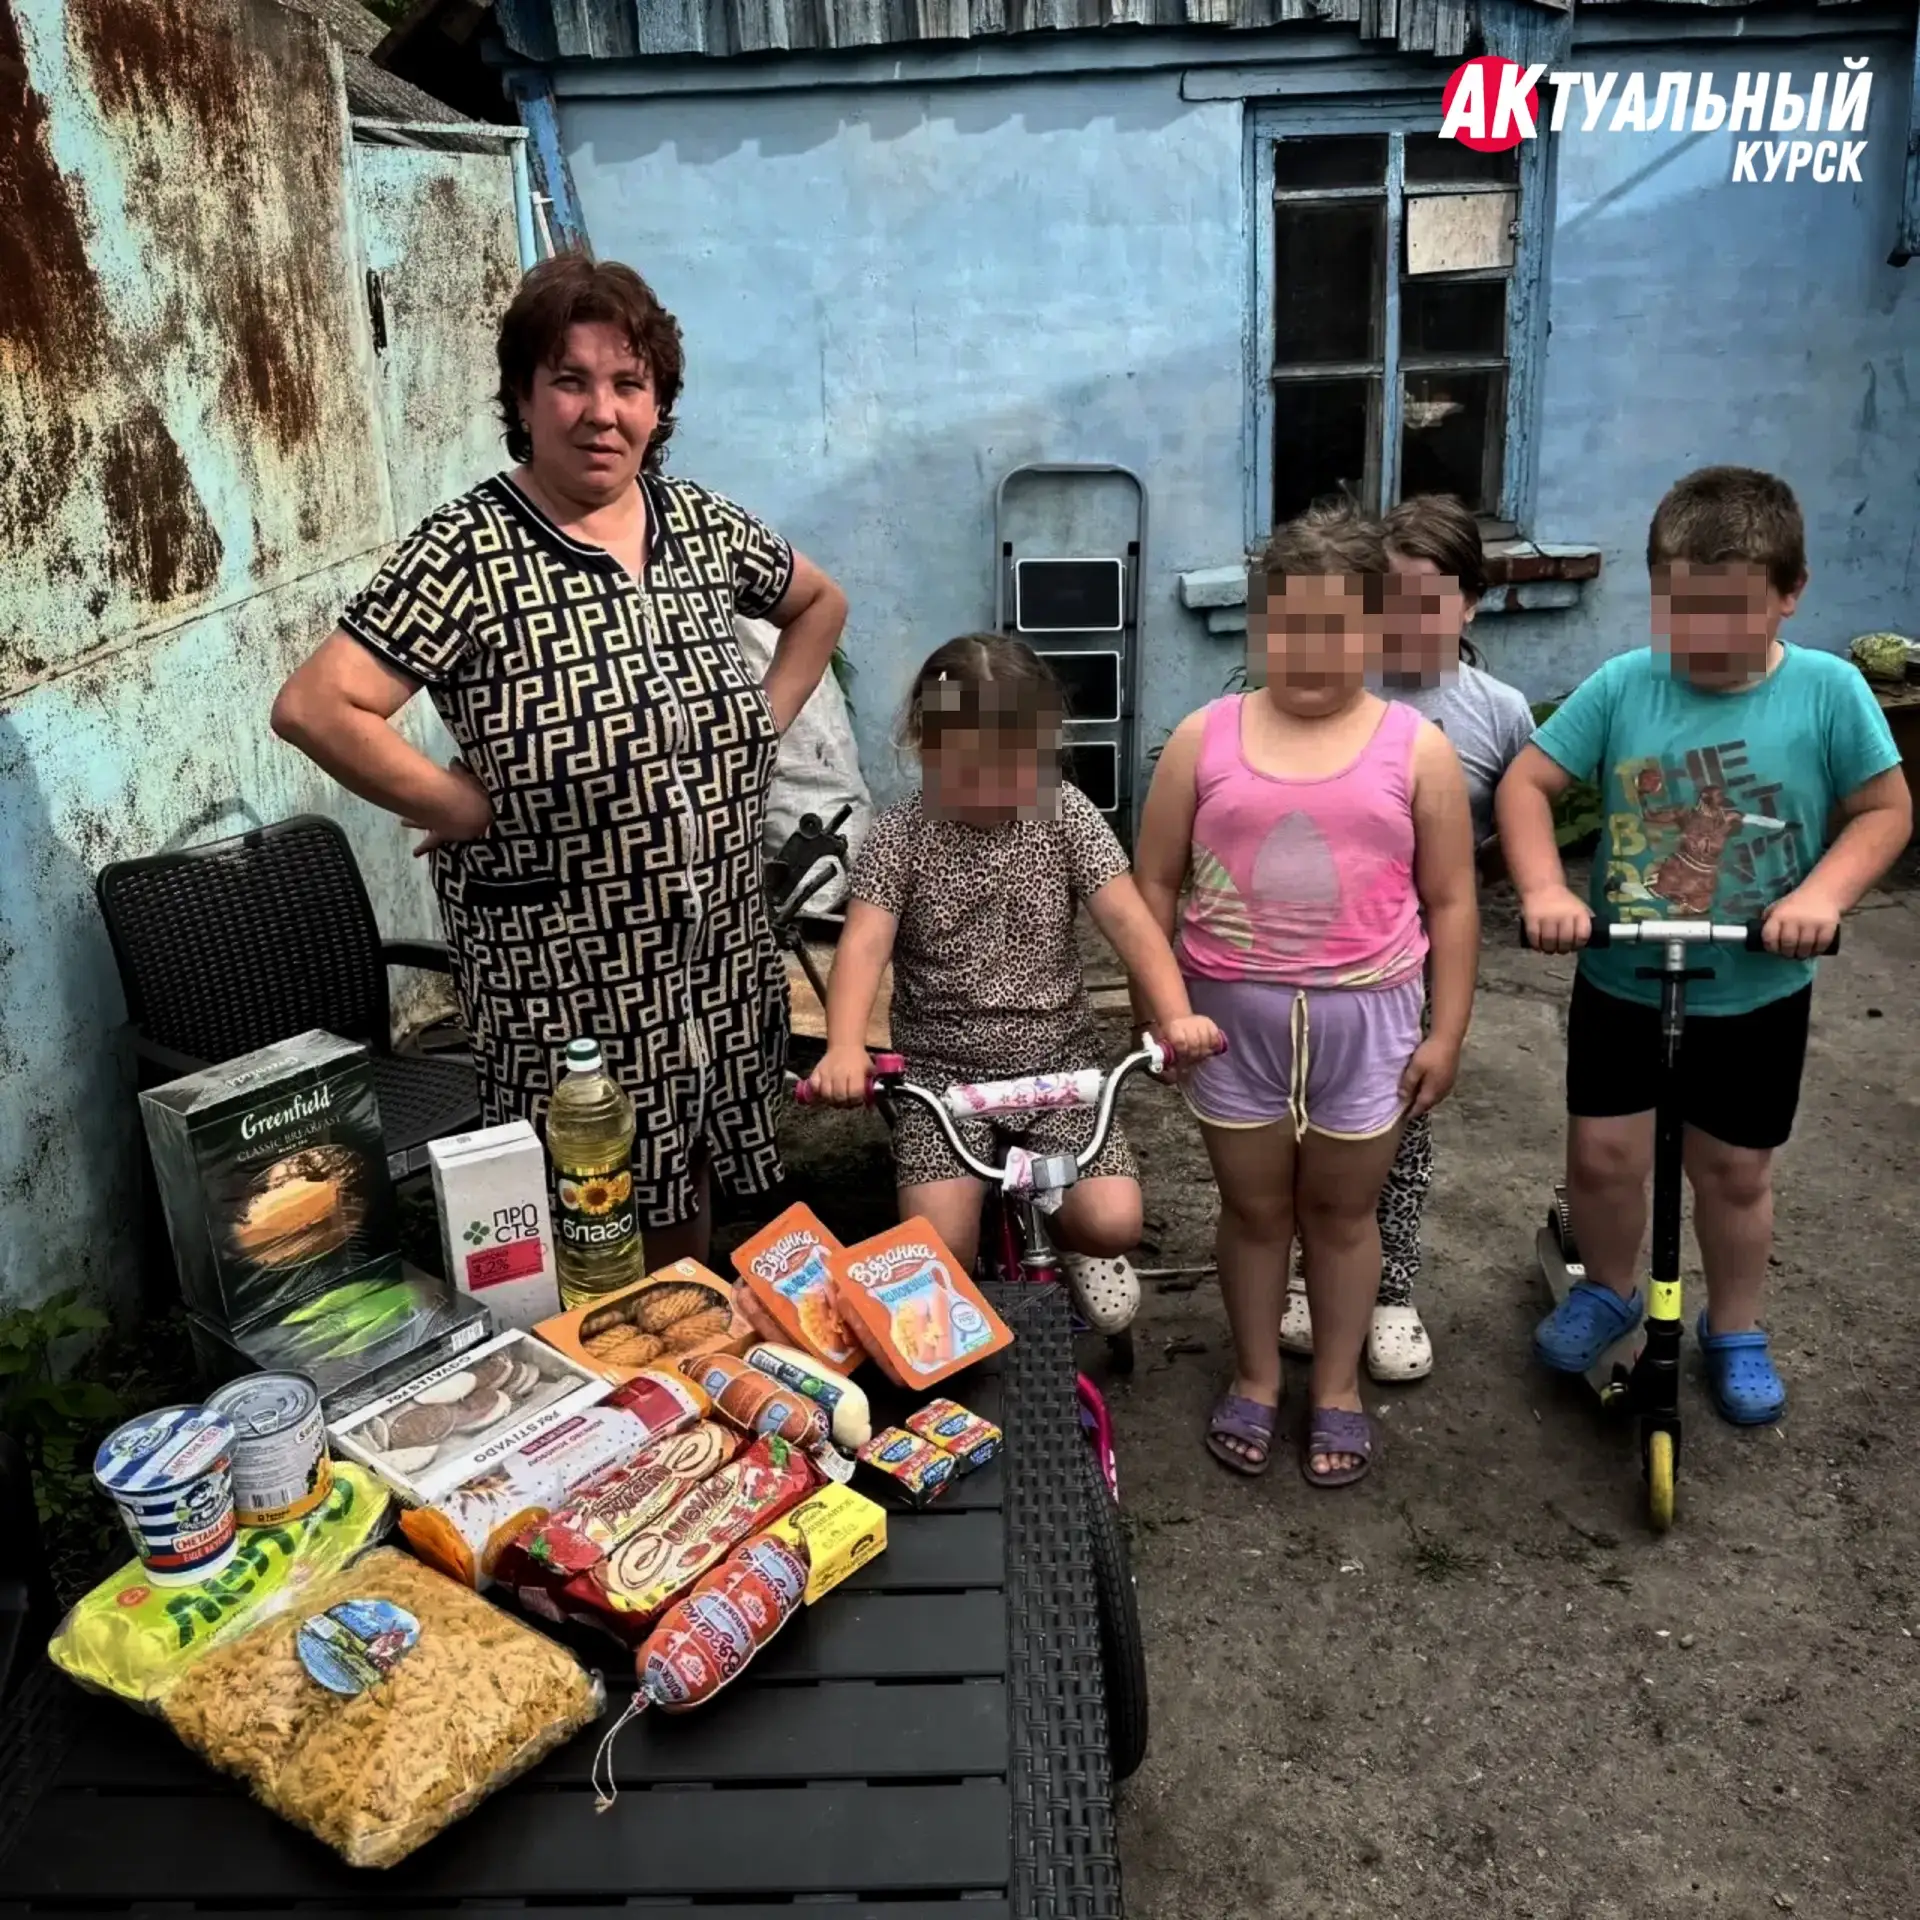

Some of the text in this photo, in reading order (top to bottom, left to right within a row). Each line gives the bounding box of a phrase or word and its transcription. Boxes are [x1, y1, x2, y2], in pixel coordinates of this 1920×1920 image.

[241, 1085, 334, 1140] Greenfield
[237, 1115, 341, 1161] CLASSIC BREAKFAST
[563, 1213, 633, 1243] благо
[751, 1230, 819, 1281] Вязанка
[847, 1243, 936, 1287] Вязанка
